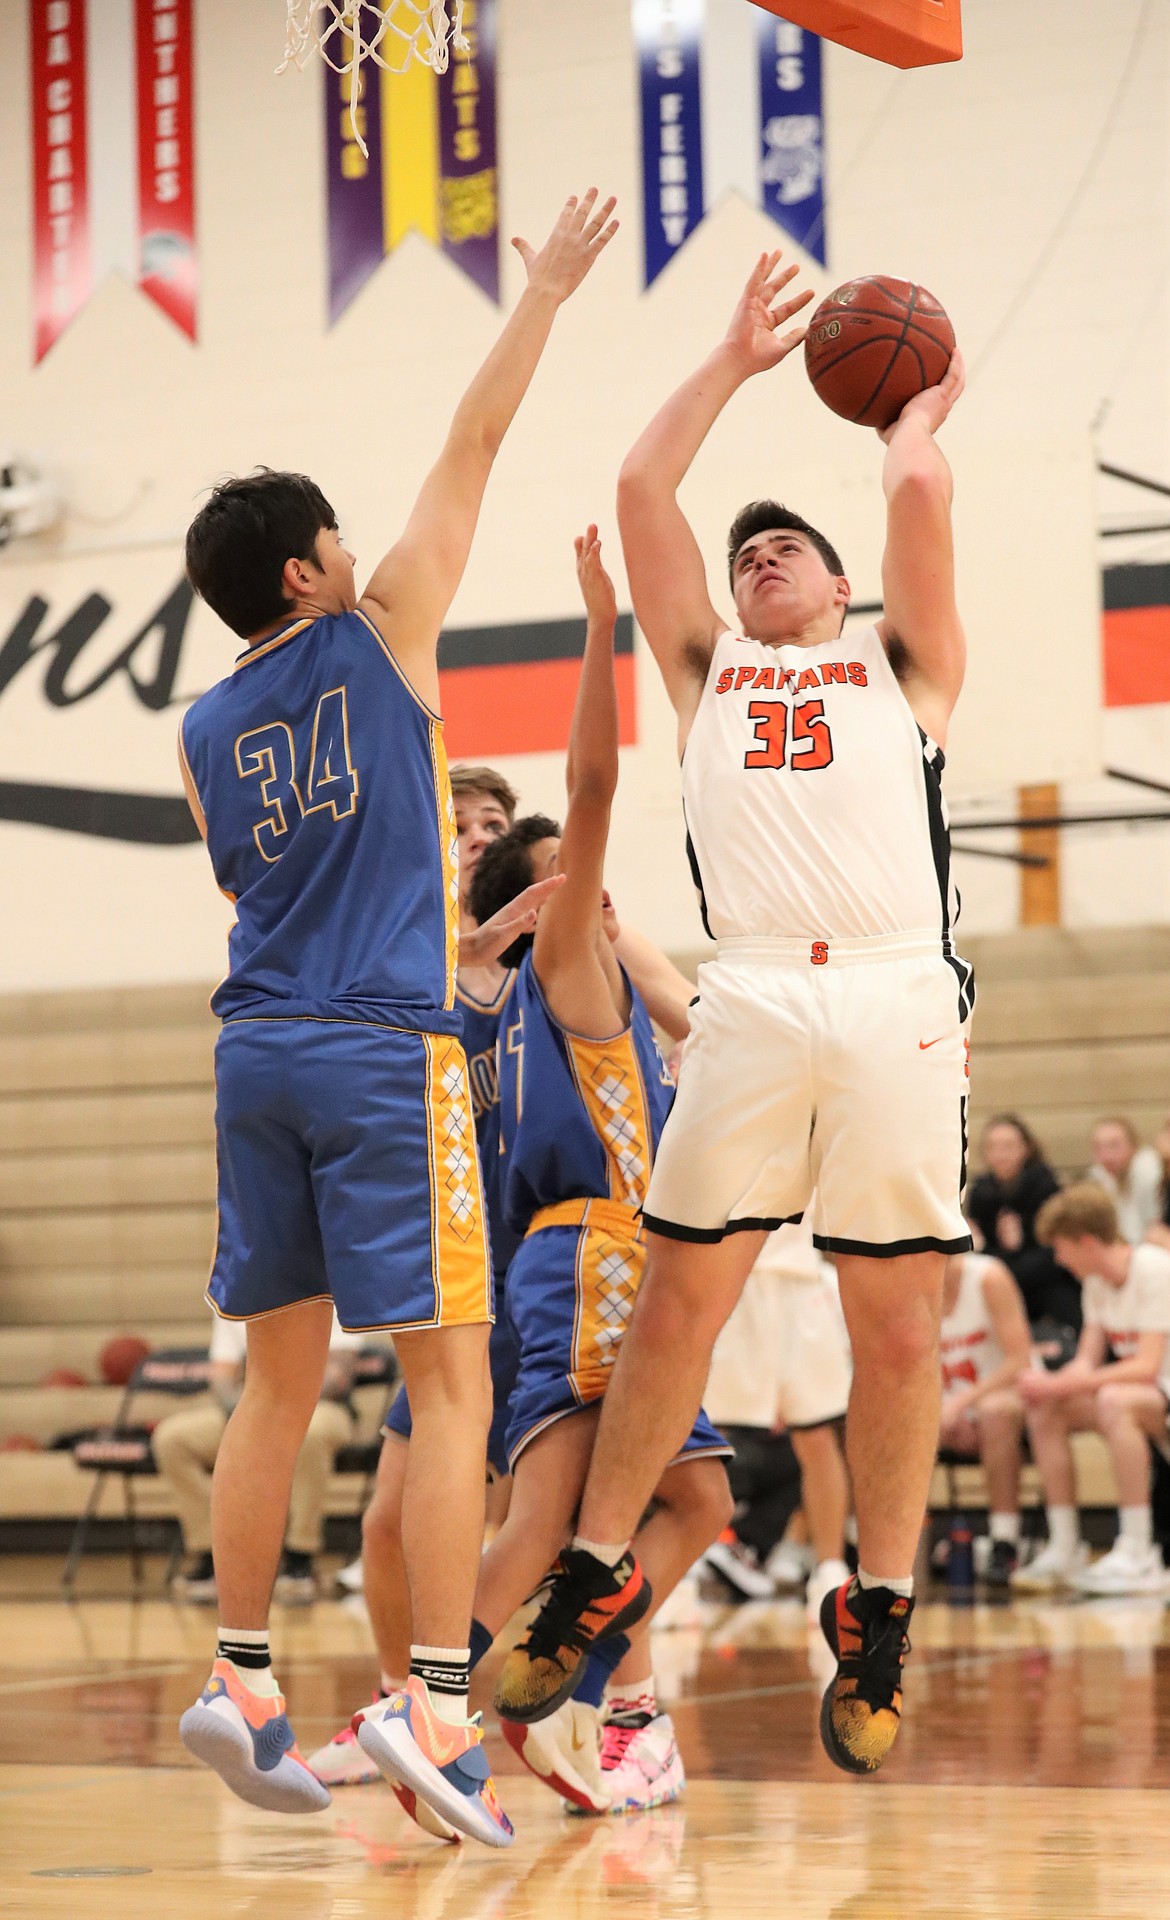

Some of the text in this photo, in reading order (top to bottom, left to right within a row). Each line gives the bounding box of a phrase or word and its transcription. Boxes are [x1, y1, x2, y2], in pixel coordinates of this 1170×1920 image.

[715, 661, 868, 694] SPARANS
[744, 699, 833, 771] 35
[234, 685, 359, 863] 34
[811, 941, 829, 965] S
